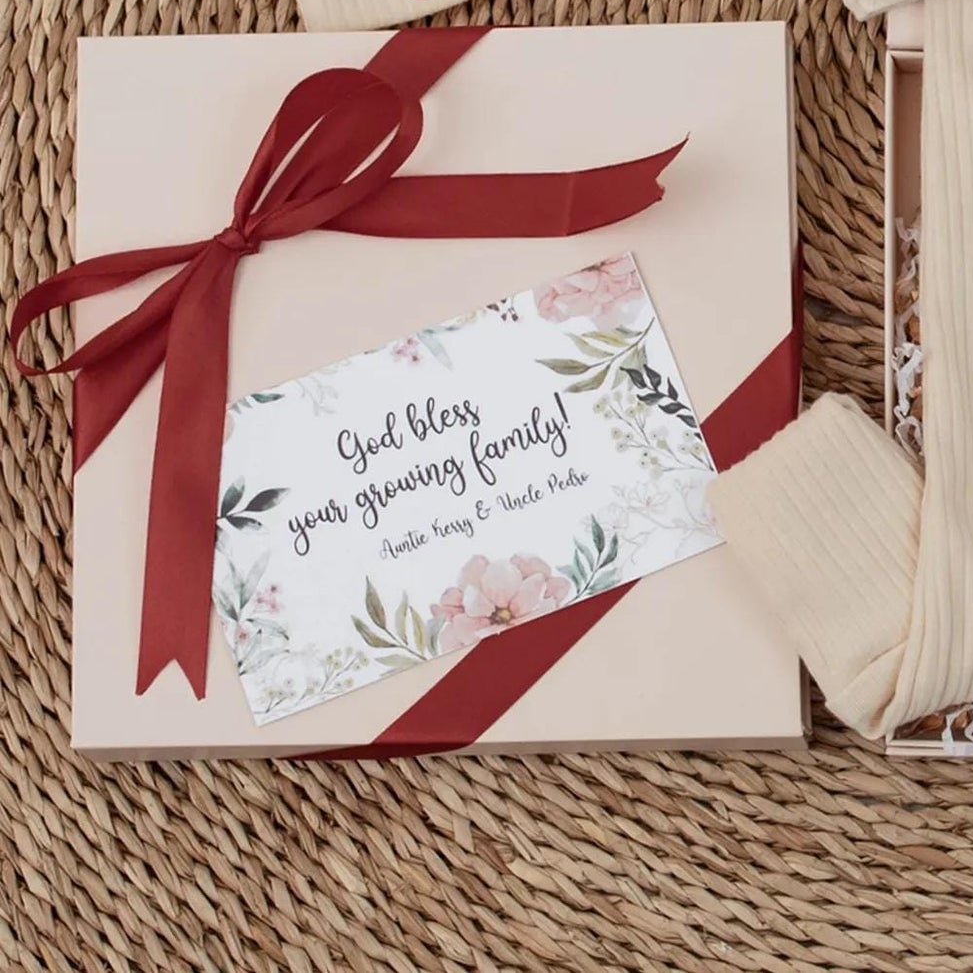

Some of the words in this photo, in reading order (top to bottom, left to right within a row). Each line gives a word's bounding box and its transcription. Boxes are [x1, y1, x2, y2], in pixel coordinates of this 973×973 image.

[288, 499, 348, 556] your
[355, 455, 466, 529] growing
[469, 392, 571, 486] family!
[337, 412, 403, 475] God
[406, 397, 481, 441] bless
[380, 529, 430, 559] Auntie
[475, 500, 491, 520] &
[496, 483, 544, 512] Uncle
[547, 467, 590, 494] Pedro
